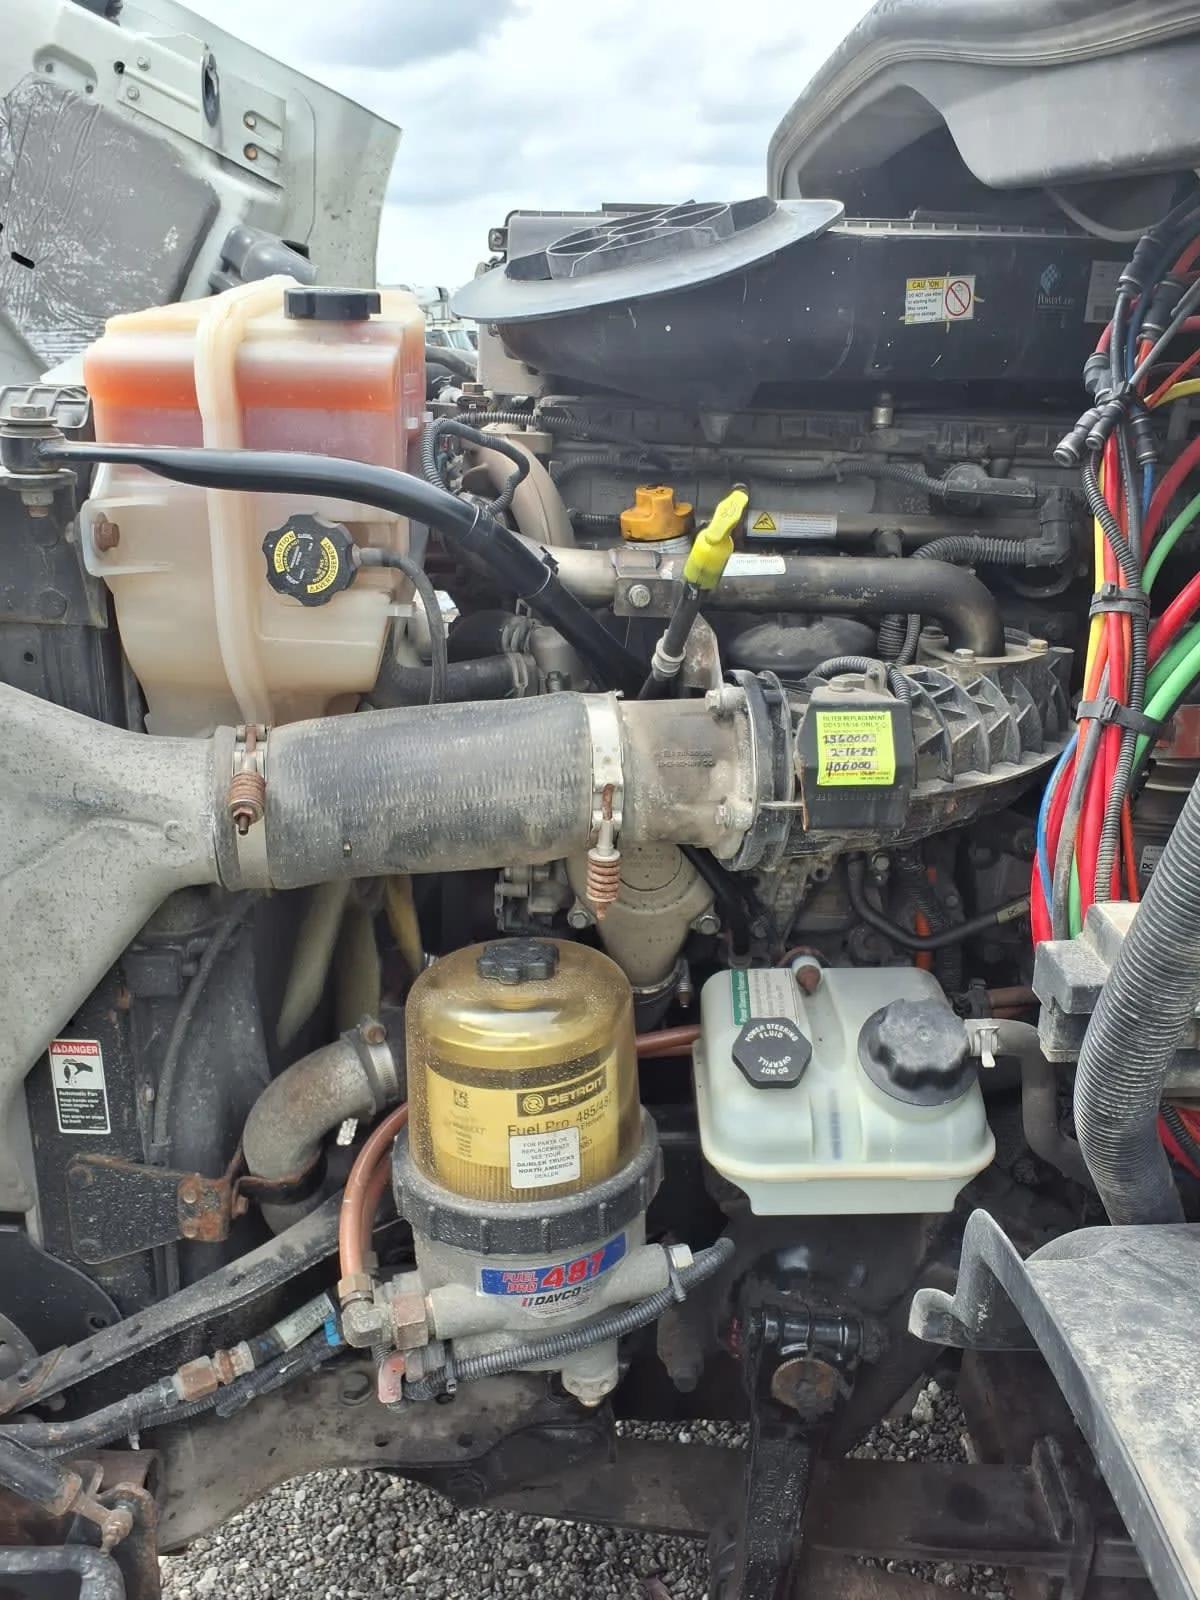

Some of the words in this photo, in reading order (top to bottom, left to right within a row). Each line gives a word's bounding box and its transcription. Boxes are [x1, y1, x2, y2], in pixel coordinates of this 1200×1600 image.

[911, 280, 940, 288] CAUION
[275, 533, 296, 563] CAUTION
[744, 1025, 765, 1042] POWER
[766, 1023, 799, 1042] STEERING
[760, 1030, 784, 1039] FLUID
[61, 1045, 98, 1054] DANGER
[758, 1055, 792, 1068] OVERFILL
[760, 1066, 776, 1075] NOT
[777, 1066, 789, 1075] DO
[547, 1074, 603, 1106] DETROIT
[507, 1122, 540, 1137] Fuel
[537, 1138, 557, 1146] PARTS
[517, 1160, 547, 1168] DAIMLER
[549, 1154, 575, 1164] TRUCKS
[544, 1161, 574, 1171] AMERICA
[503, 1271, 537, 1283] FUEL
[540, 1247, 605, 1289] 487
[507, 1282, 537, 1294] PRO
[534, 1286, 582, 1306] DAVCO
